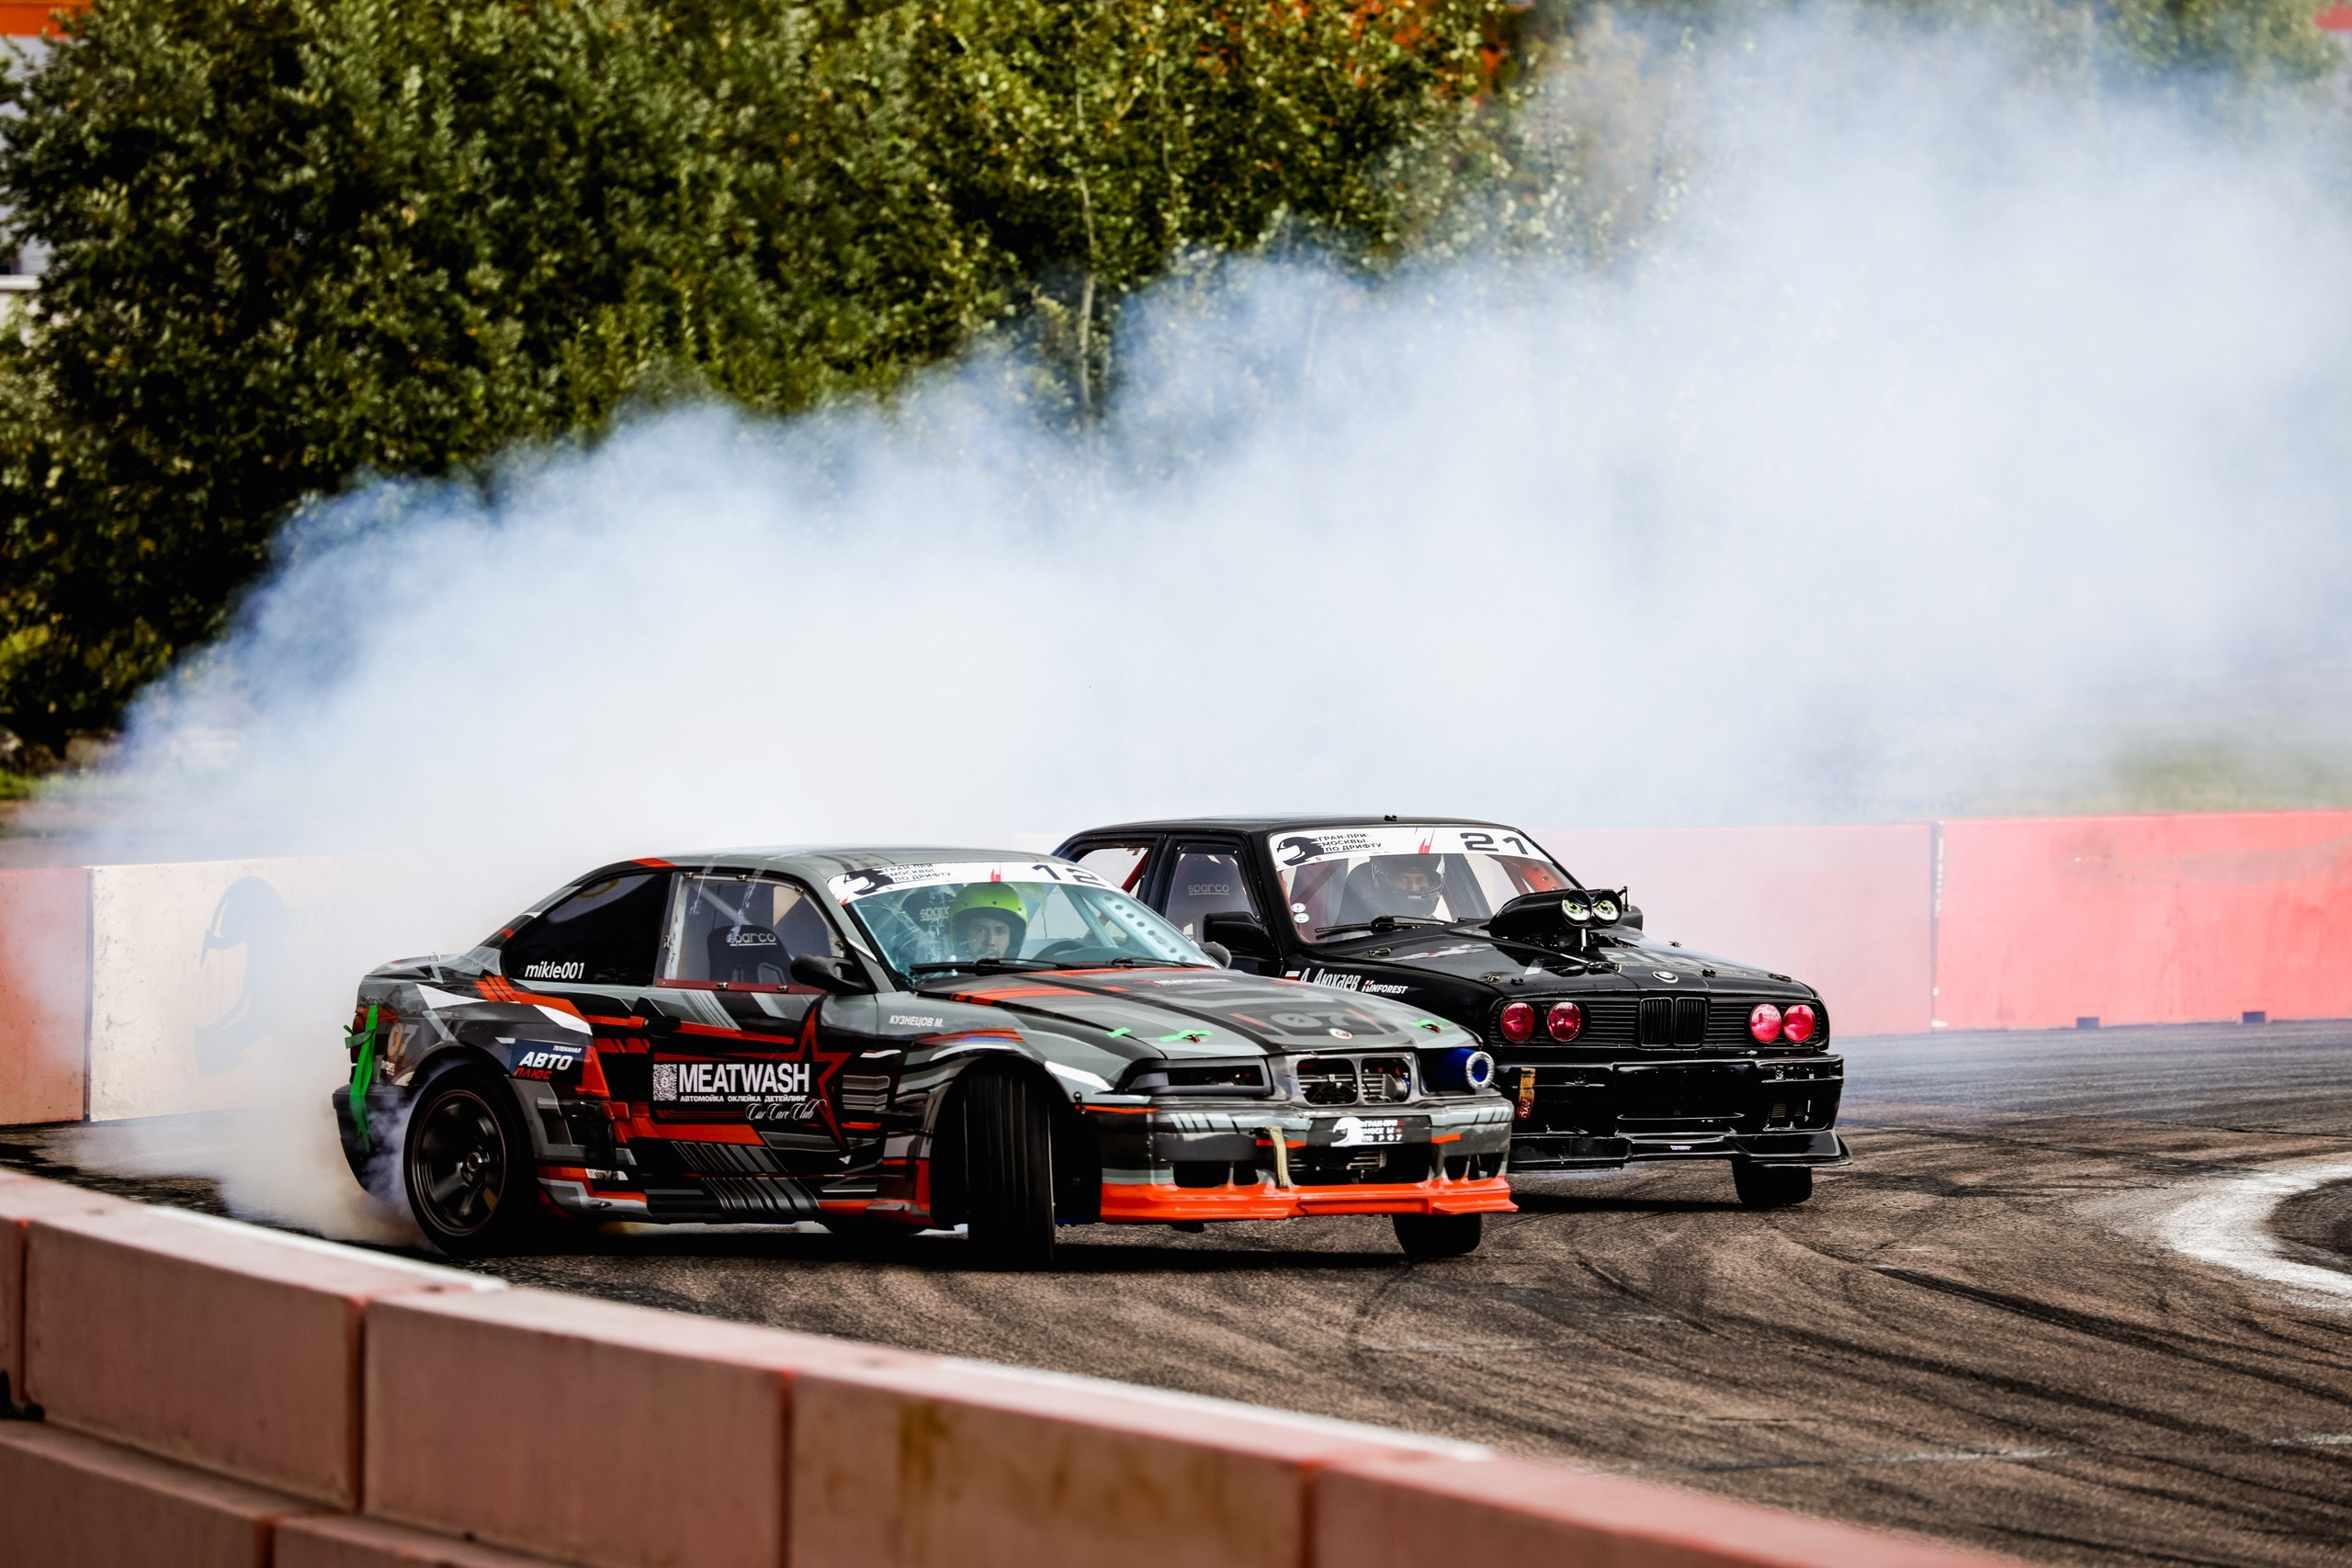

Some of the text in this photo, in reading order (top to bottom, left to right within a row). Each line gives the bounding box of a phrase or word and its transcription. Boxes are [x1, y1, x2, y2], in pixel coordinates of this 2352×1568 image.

[1342, 842, 1382, 851] ДРИФТУ
[1459, 832, 1529, 855] 21
[1032, 864, 1107, 887] 12
[1188, 884, 1229, 896] sparco
[920, 906, 951, 922] sparc
[525, 961, 585, 979] mikle001
[889, 1015, 934, 1027] КУЗНЕЦОВ
[518, 1051, 573, 1071] АВТО
[514, 1066, 553, 1080] ПЛЮС
[678, 1063, 810, 1093] MEATWASH
[680, 1094, 808, 1103] АВТОМОЙКА ОКЛЕЙКА ДЕТЕЙЛИНГ
